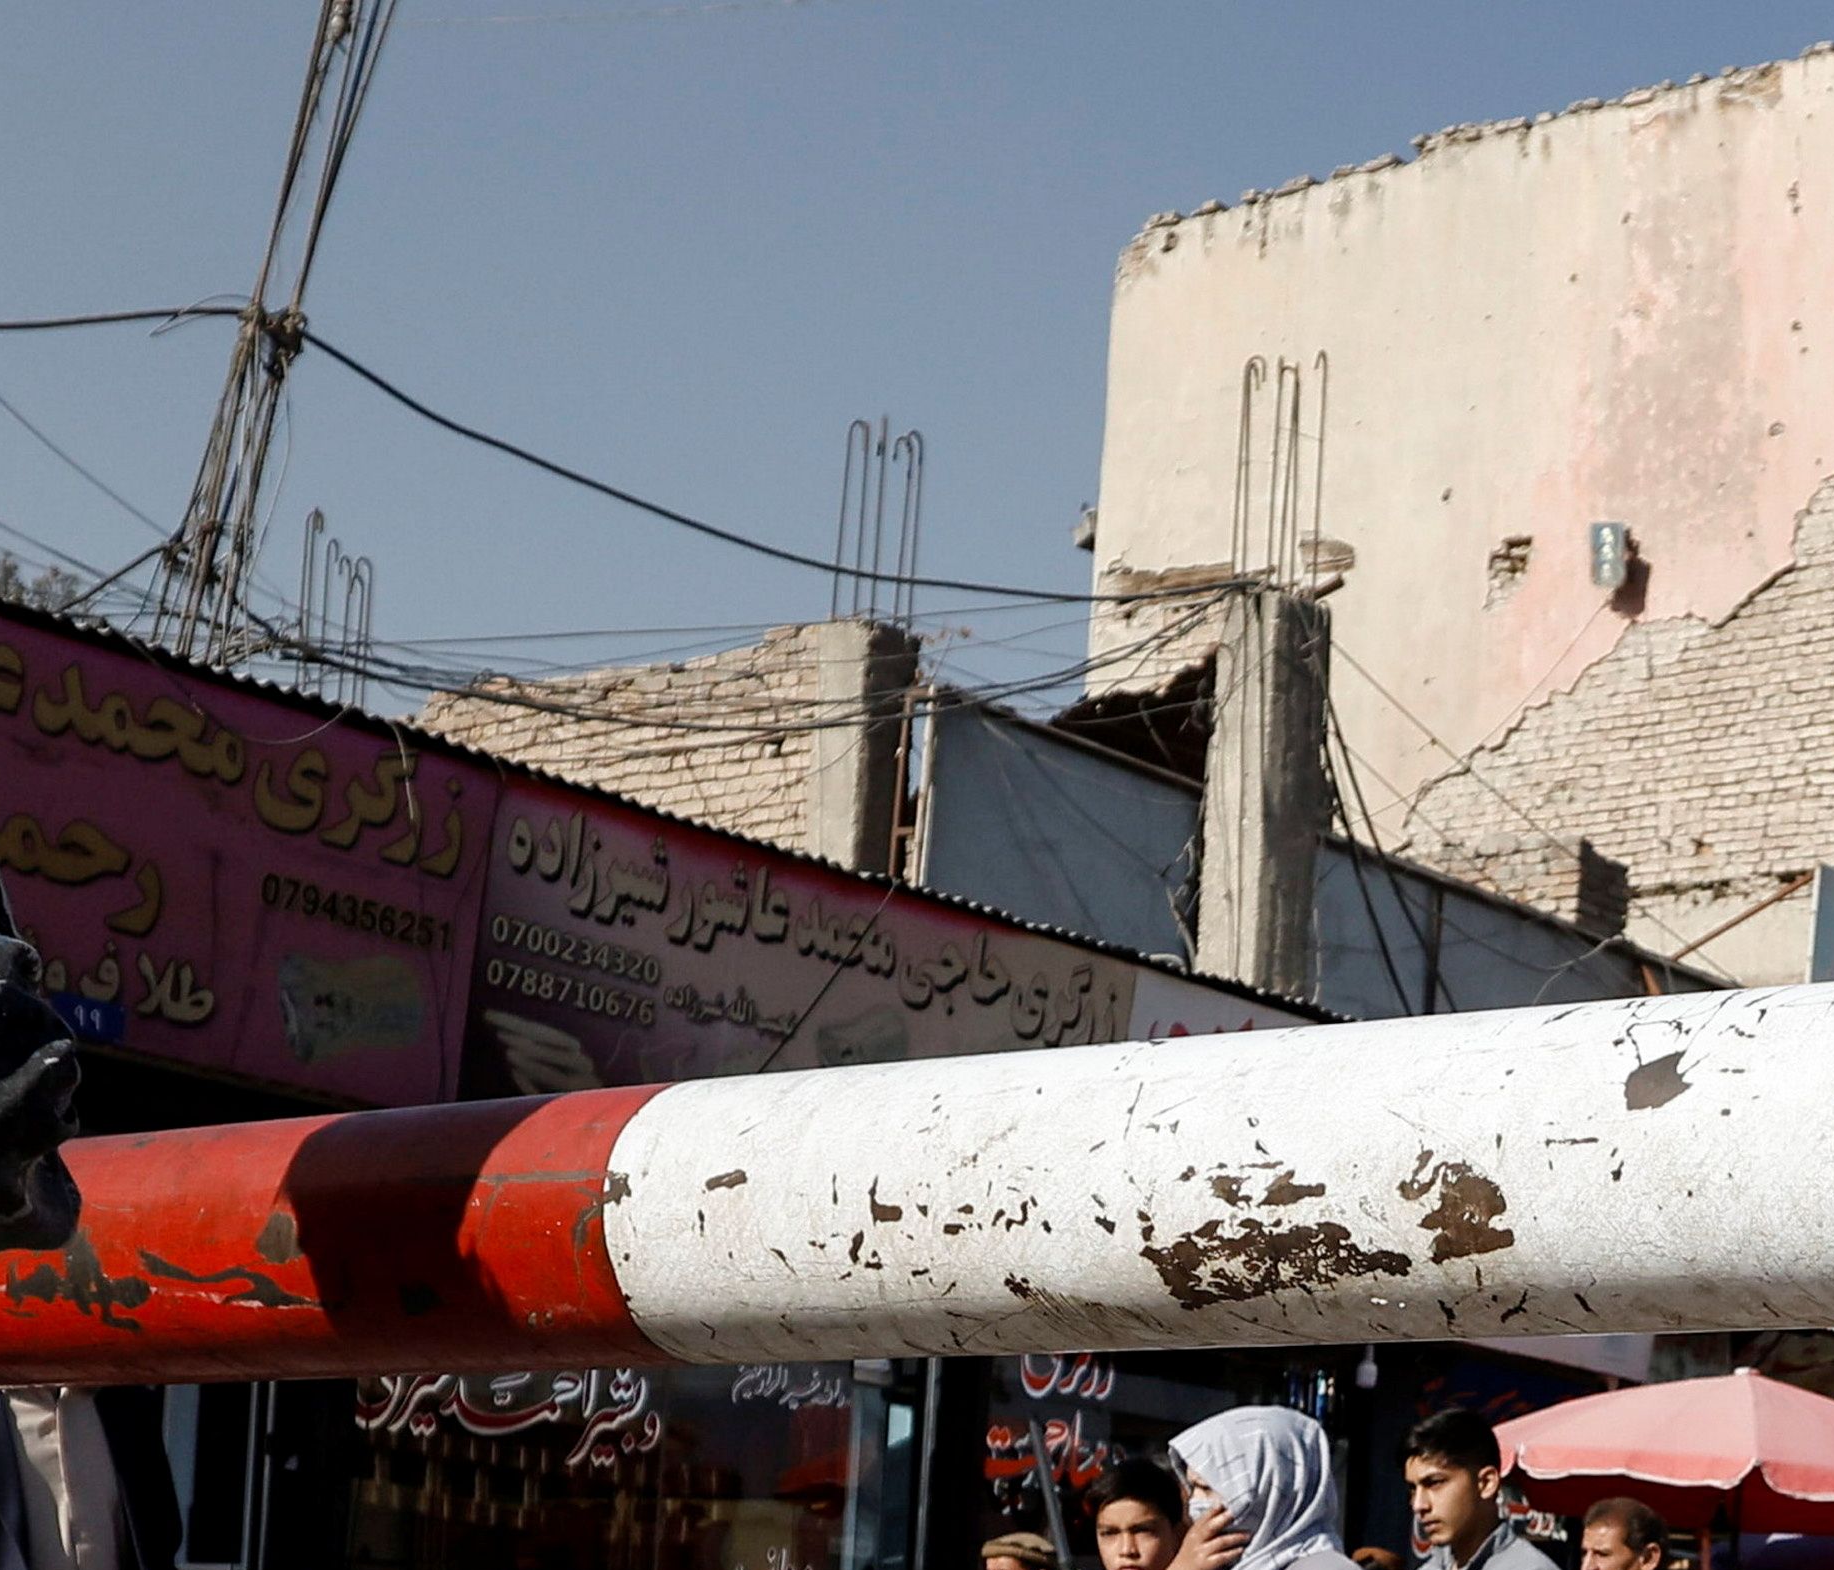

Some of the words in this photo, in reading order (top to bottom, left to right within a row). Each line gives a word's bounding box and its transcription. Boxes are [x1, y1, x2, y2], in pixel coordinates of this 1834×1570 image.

[32, 664, 246, 785] محمد
[254, 747, 463, 878] زرگری
[507, 811, 671, 927] شیرزاده
[666, 863, 790, 951] عاشور
[262, 873, 452, 951] 0794356251
[492, 917, 659, 985] 0700234320
[794, 898, 896, 978] محمد
[135, 950, 215, 1027] طلا
[486, 959, 657, 1026] 0788710676
[897, 932, 1011, 1015] حاجی
